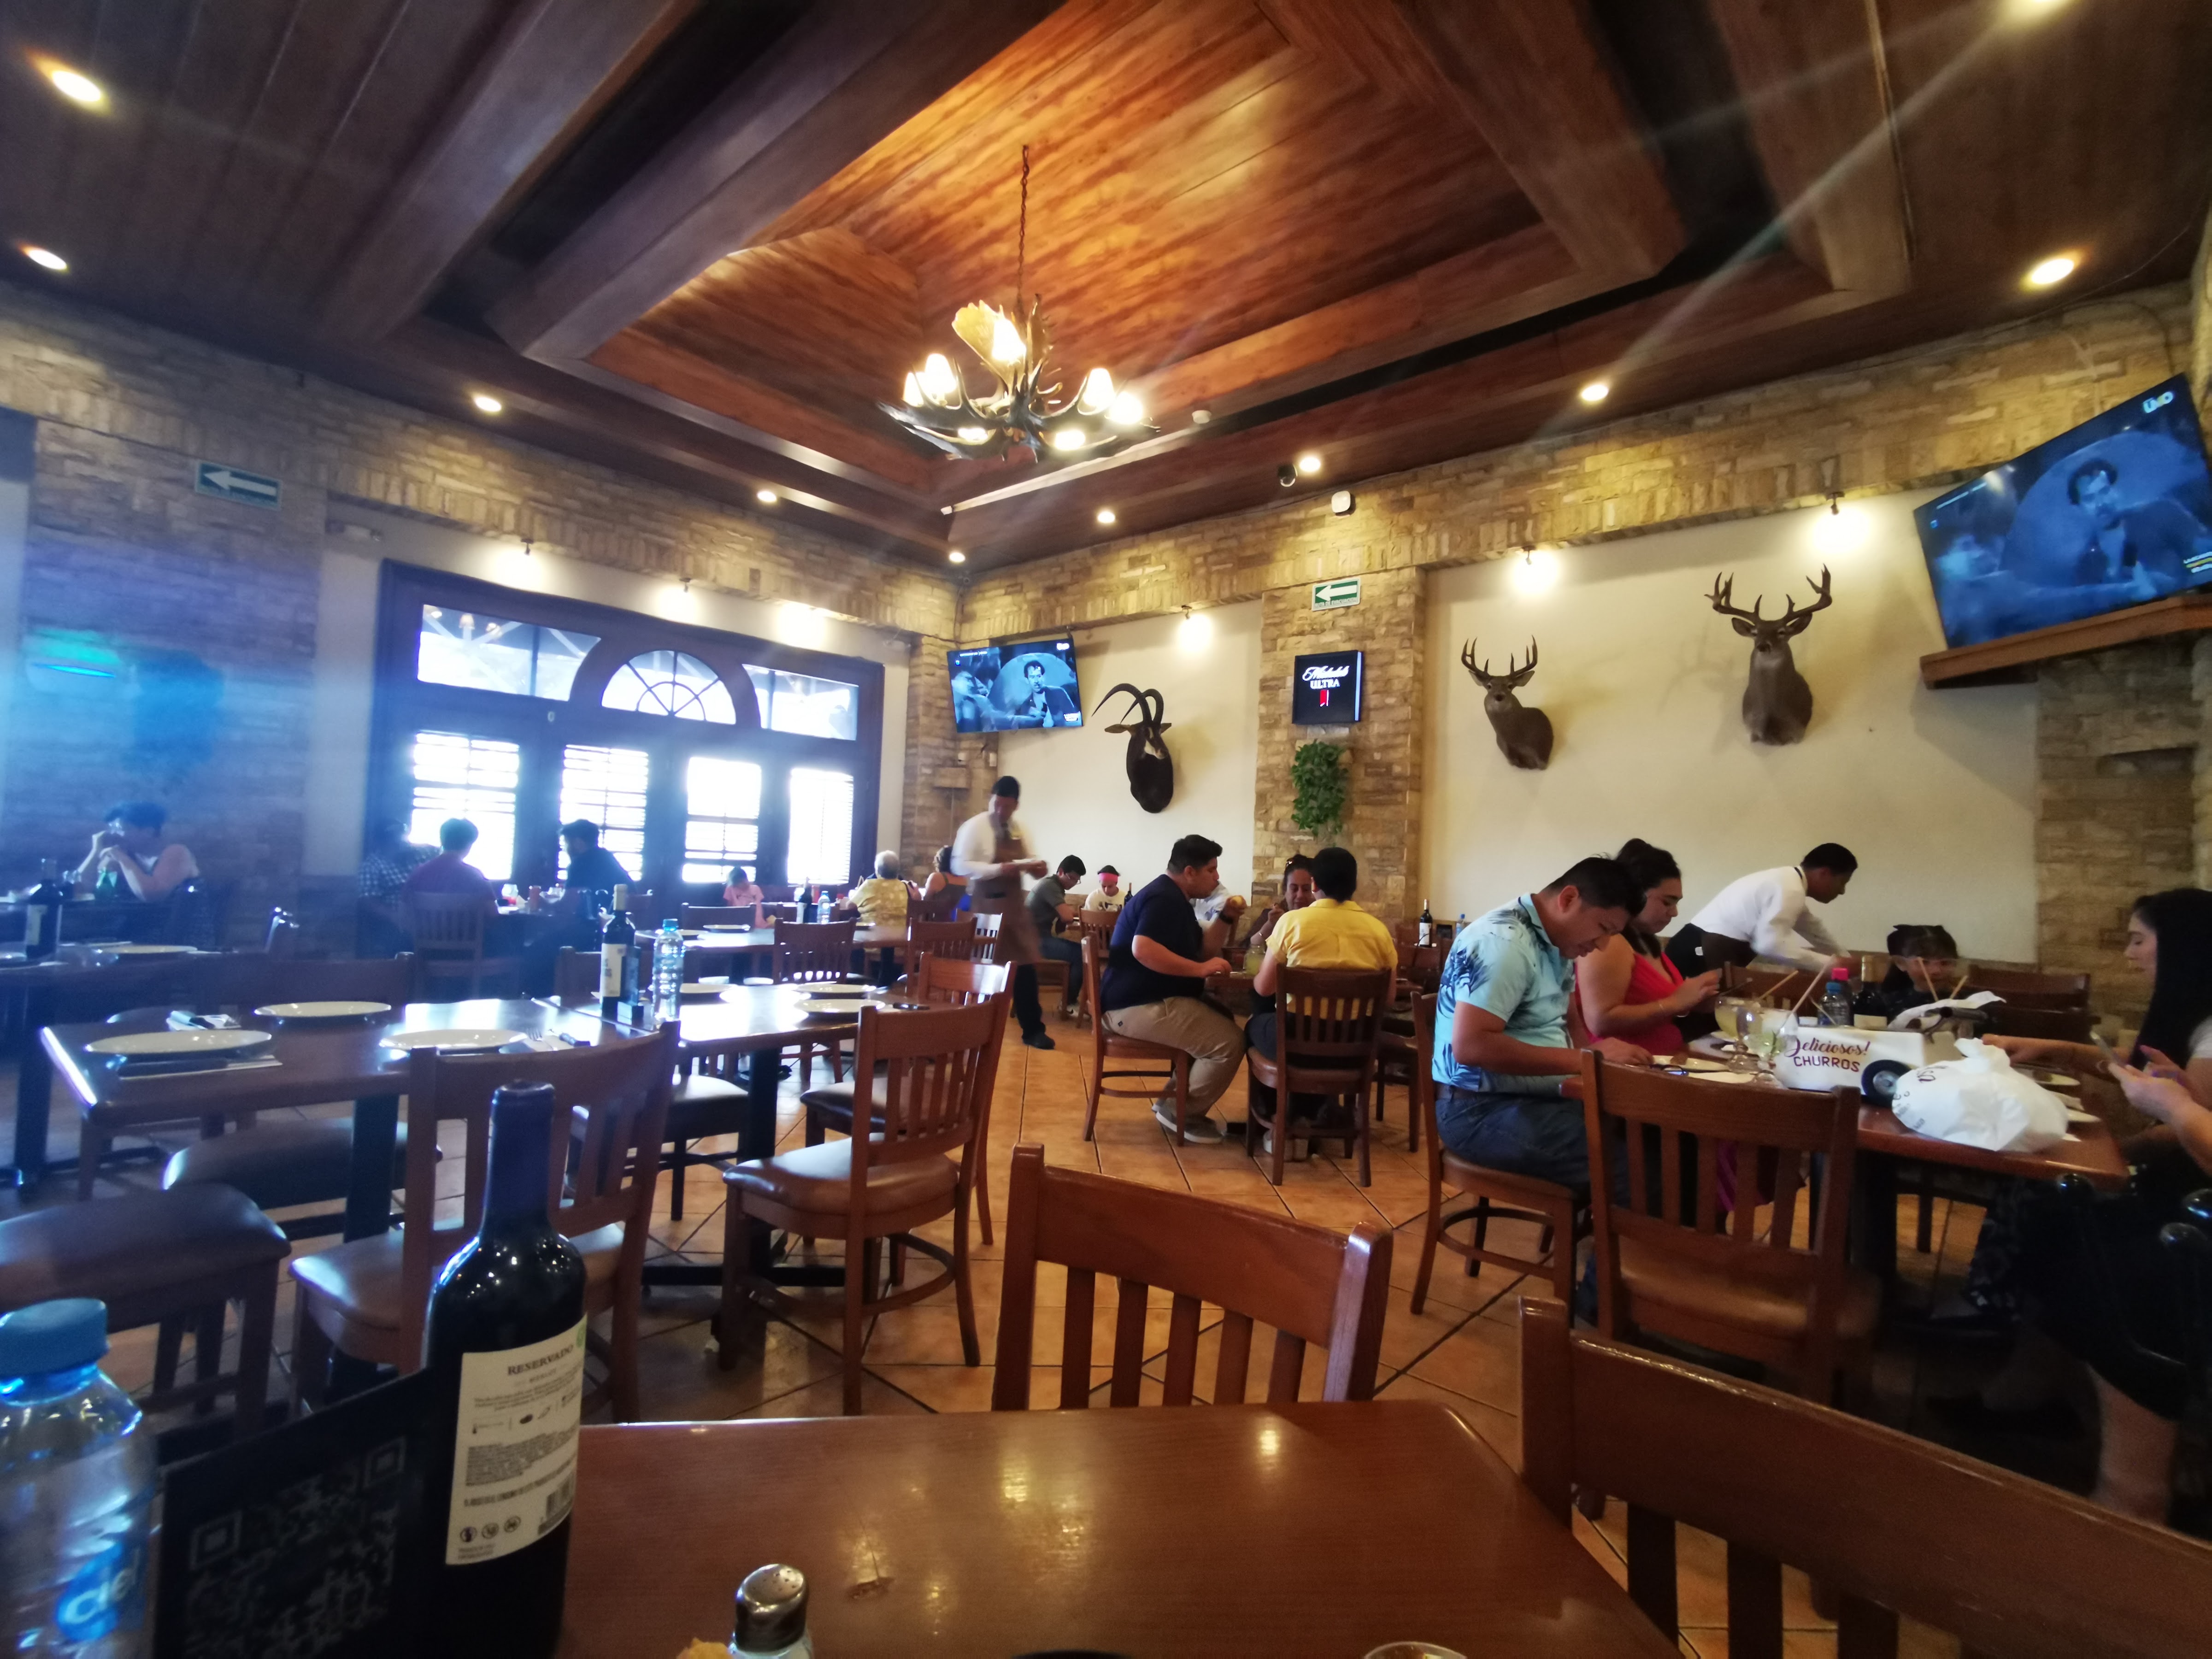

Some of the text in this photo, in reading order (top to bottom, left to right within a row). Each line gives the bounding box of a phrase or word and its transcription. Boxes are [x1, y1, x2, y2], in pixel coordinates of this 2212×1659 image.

[1310, 678, 1340, 689] ULTRA
[1794, 1056, 1860, 1072] CHURROS
[508, 1344, 573, 1375] RESERVADO
